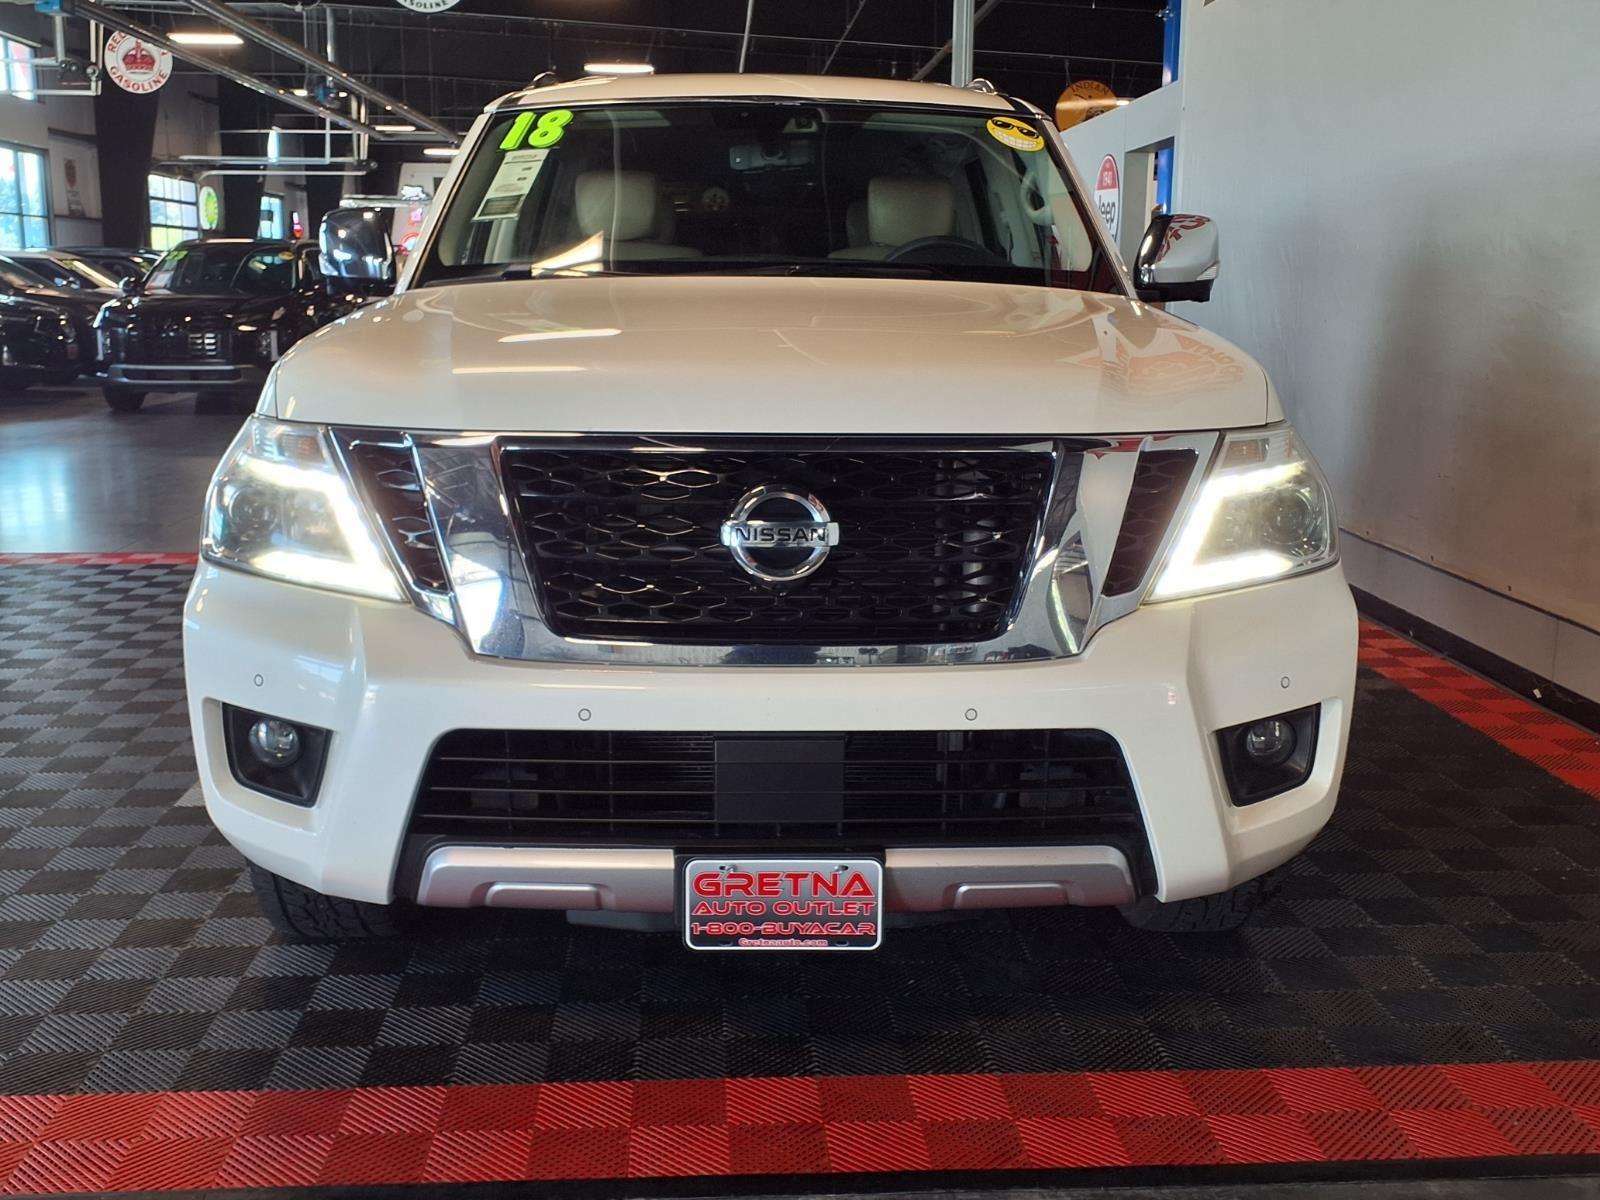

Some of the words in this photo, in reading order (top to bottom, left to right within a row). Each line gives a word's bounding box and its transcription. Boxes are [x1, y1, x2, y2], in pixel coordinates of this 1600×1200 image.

[110, 66, 168, 91] GASOLINE
[1071, 81, 1110, 95] INDIAN
[499, 109, 574, 150] 18
[735, 526, 826, 542] NISSAN
[692, 871, 876, 898] GRETNA
[692, 901, 766, 915] AUTO
[773, 901, 877, 915] OUTLET
[691, 921, 876, 936] 1-800-BUYACAR
